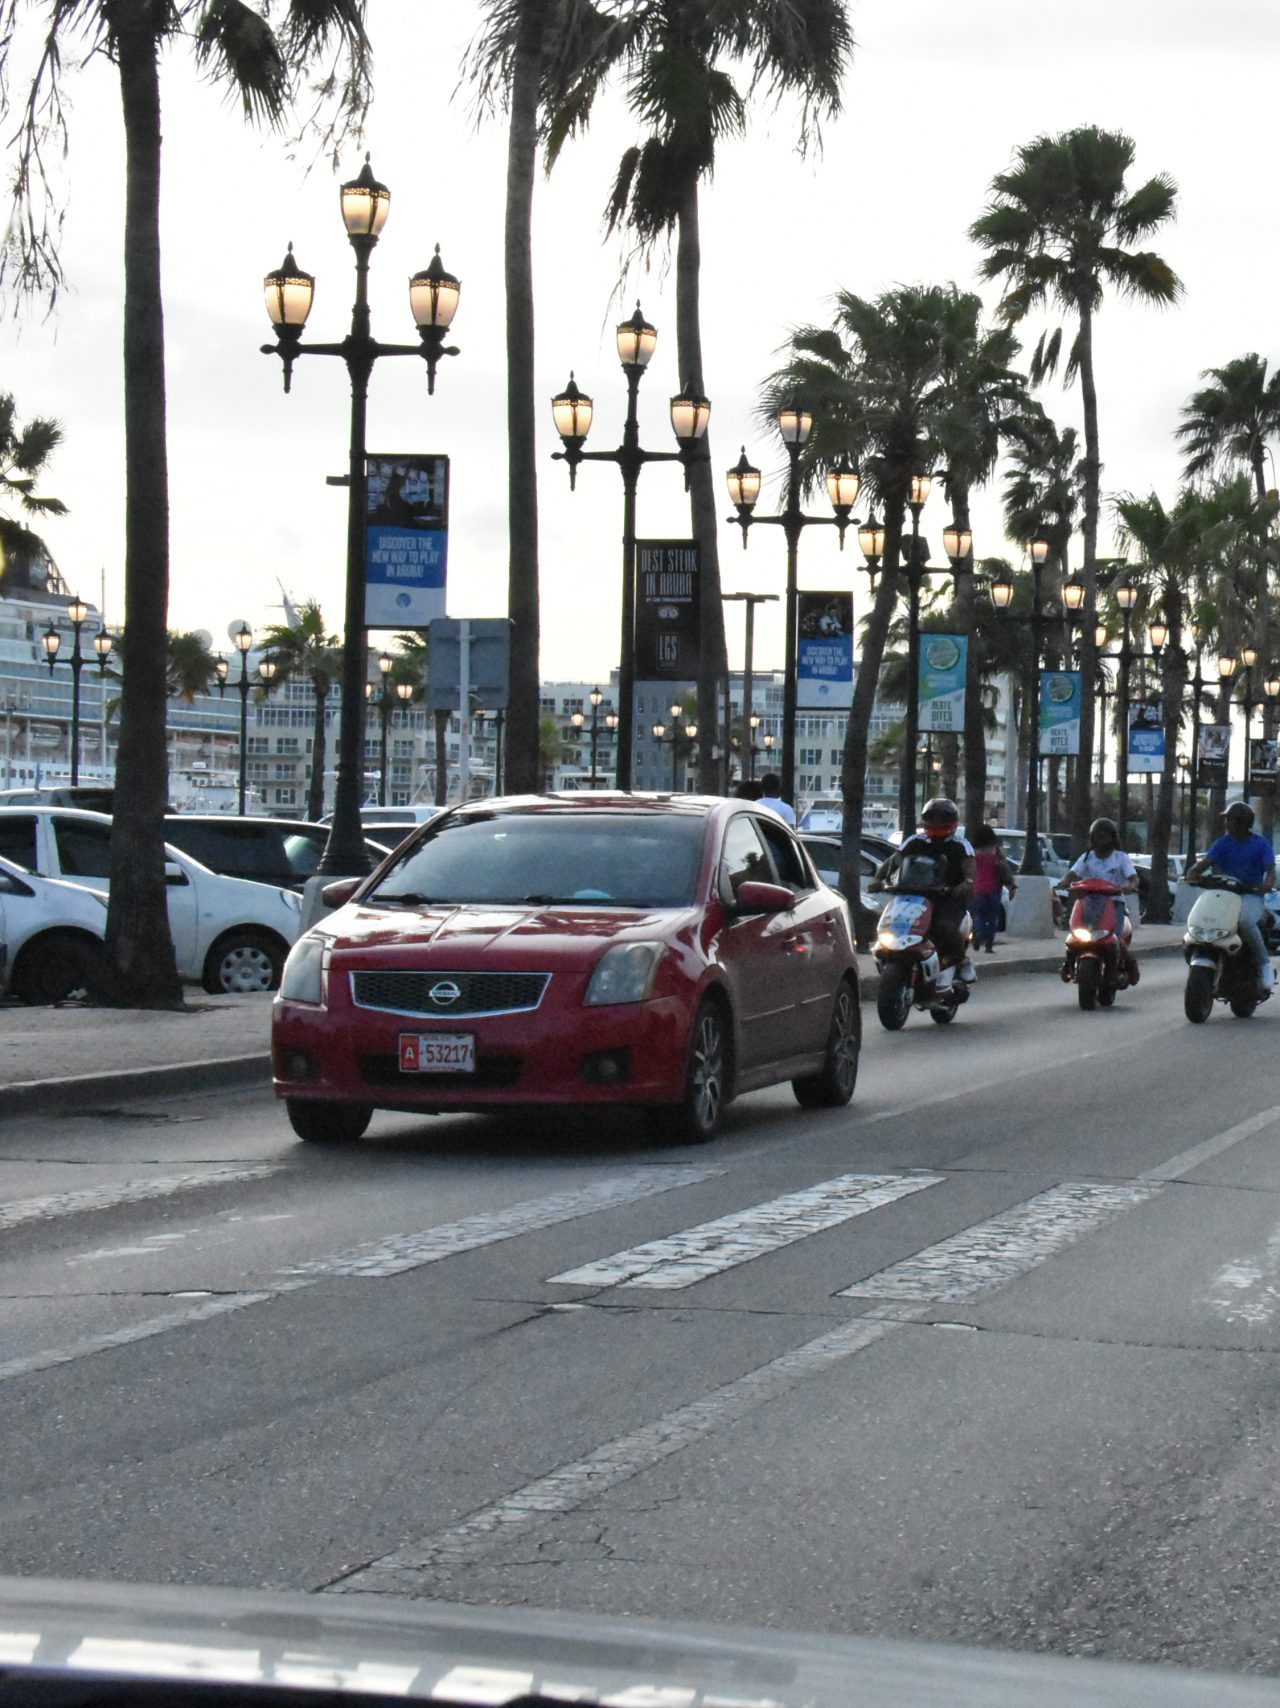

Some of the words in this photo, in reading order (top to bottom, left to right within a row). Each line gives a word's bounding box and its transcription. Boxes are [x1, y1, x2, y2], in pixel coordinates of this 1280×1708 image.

[379, 536, 416, 549] DISCOVER
[418, 537, 432, 550] THE
[372, 550, 389, 563] NEW
[391, 550, 408, 563] WAY
[409, 551, 419, 563] TO
[420, 551, 439, 564] PLAY
[641, 549, 663, 572] BEST
[668, 549, 697, 572] STEAK
[386, 564, 395, 577] IN
[646, 572, 656, 595] IN
[660, 572, 692, 595] ARUBA
